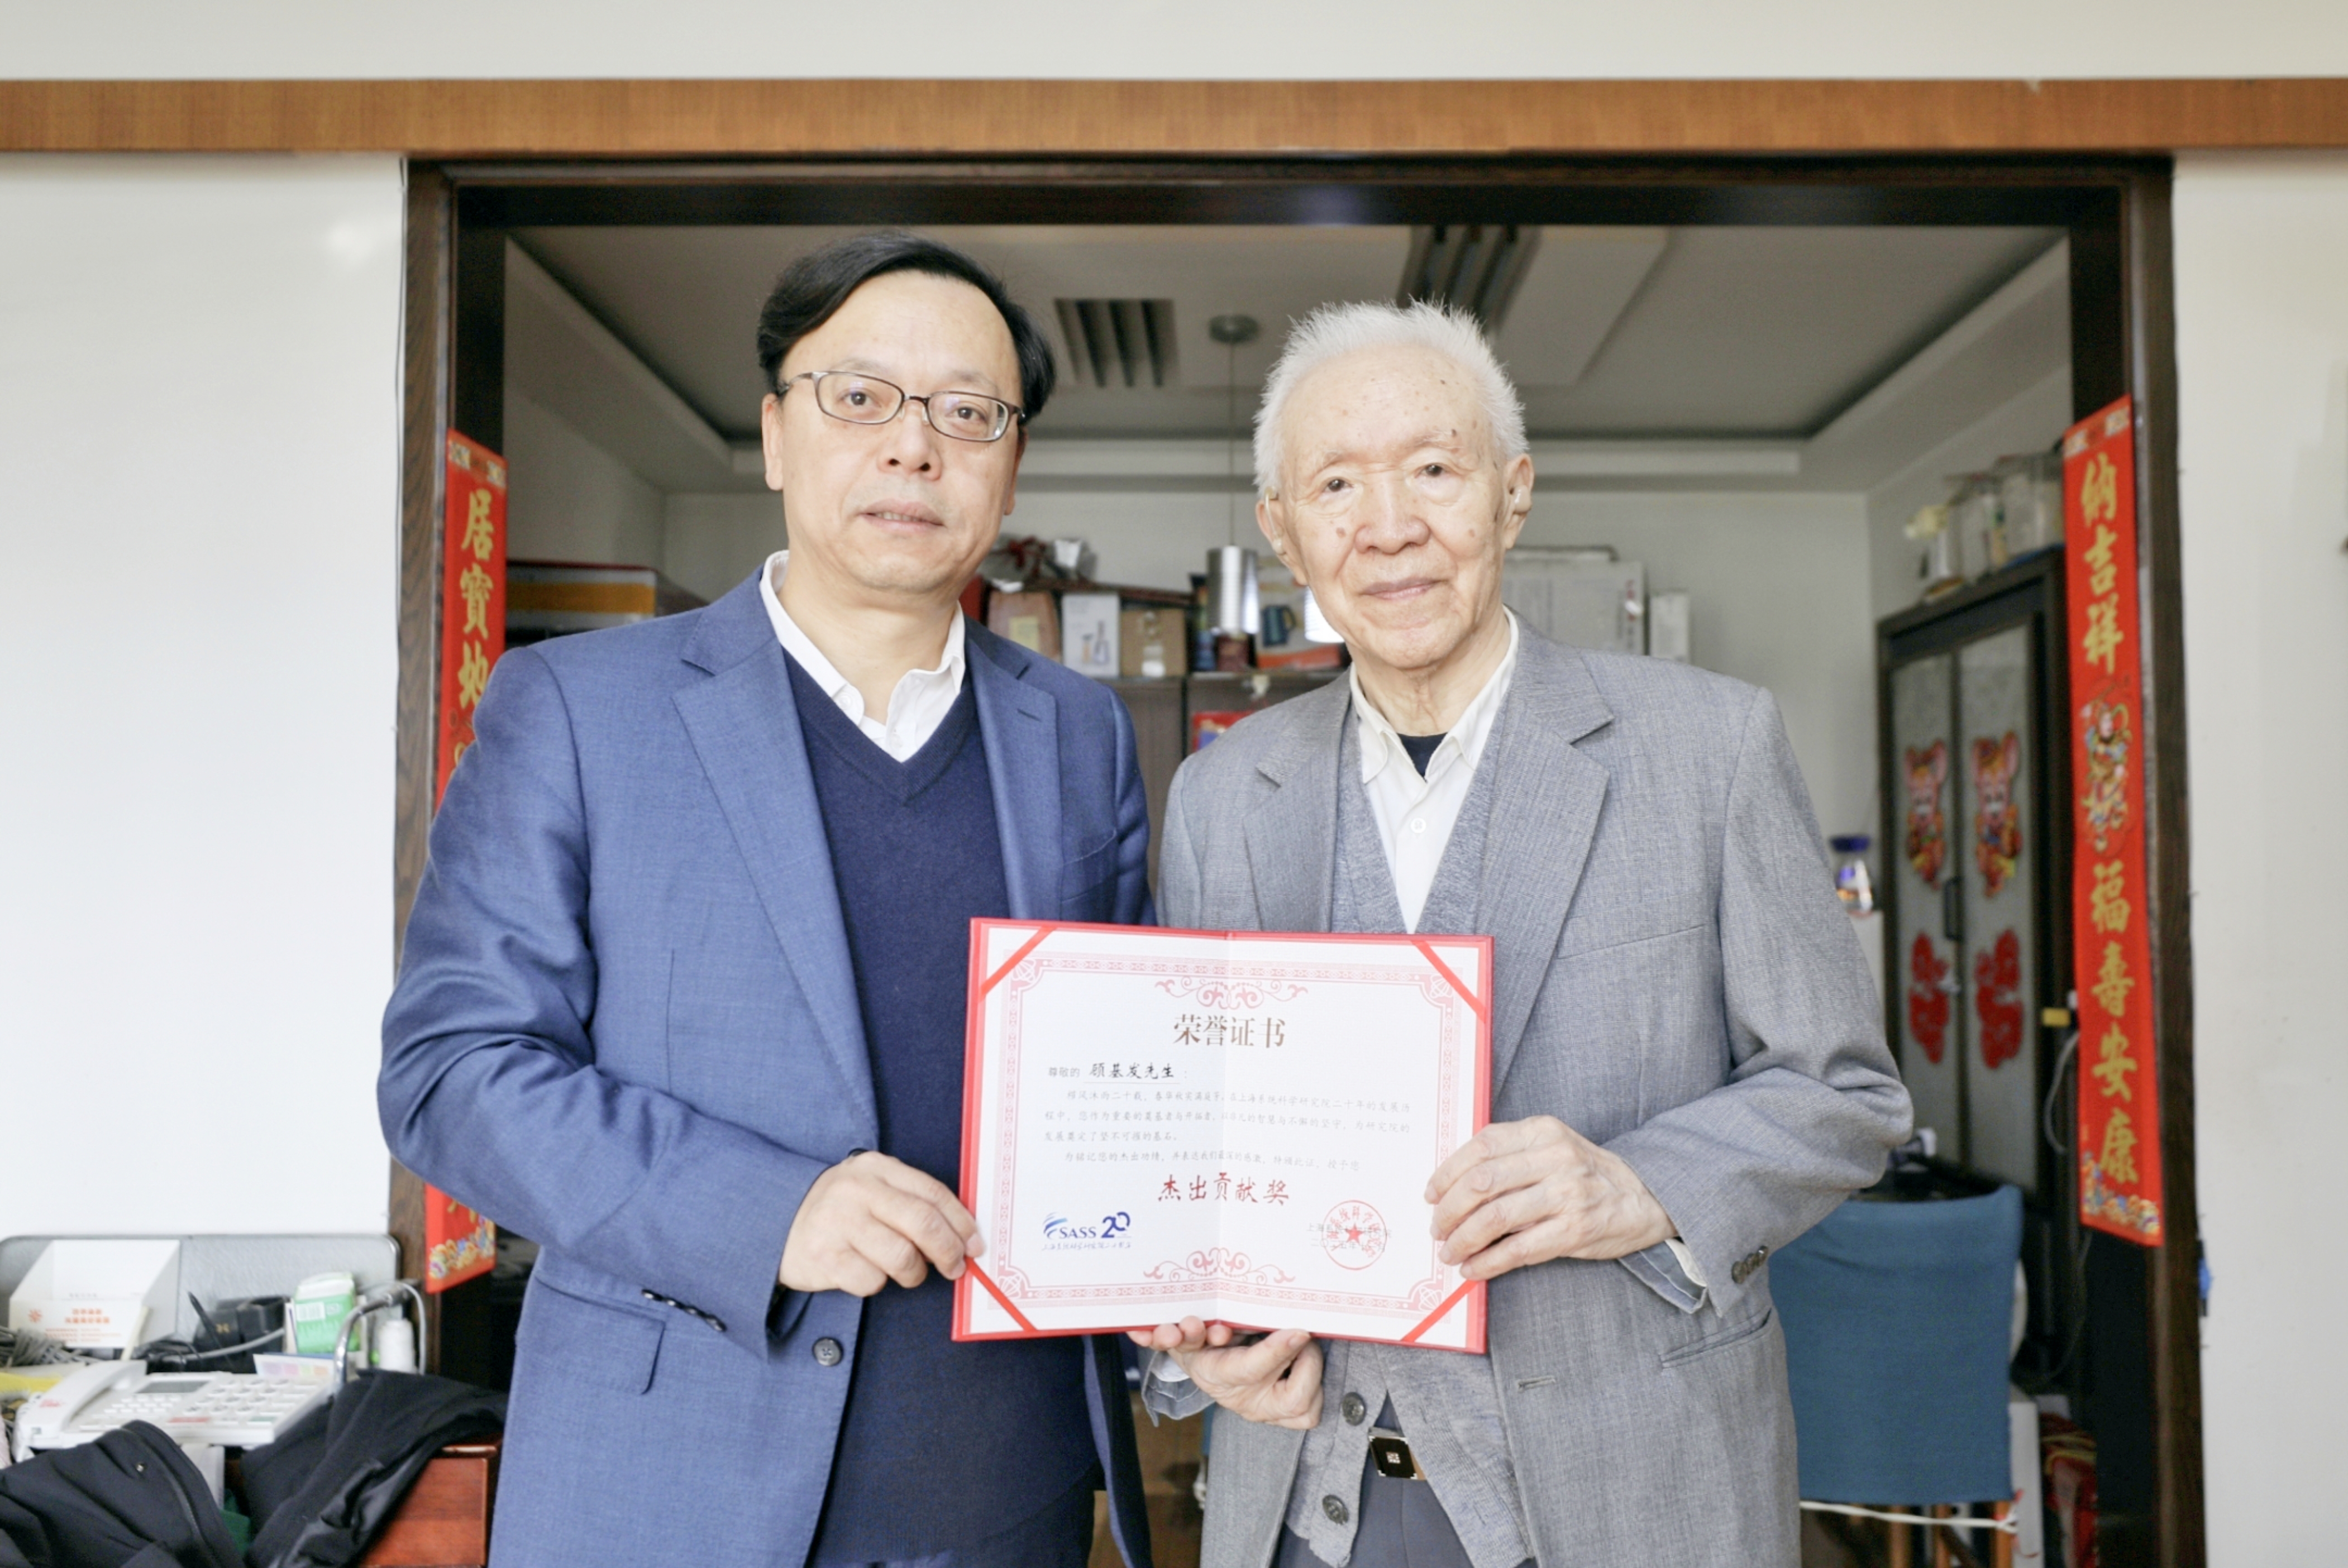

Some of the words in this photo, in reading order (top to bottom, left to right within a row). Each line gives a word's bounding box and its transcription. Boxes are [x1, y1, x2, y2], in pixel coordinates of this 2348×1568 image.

[1173, 1014, 1286, 1048] 荣誉证书
[1048, 1067, 1081, 1078] 尊敬的
[1158, 1172, 1289, 1206] 杰出贡献奖
[1059, 1227, 1097, 1239] SASS
[1101, 1211, 1131, 1239] 20
